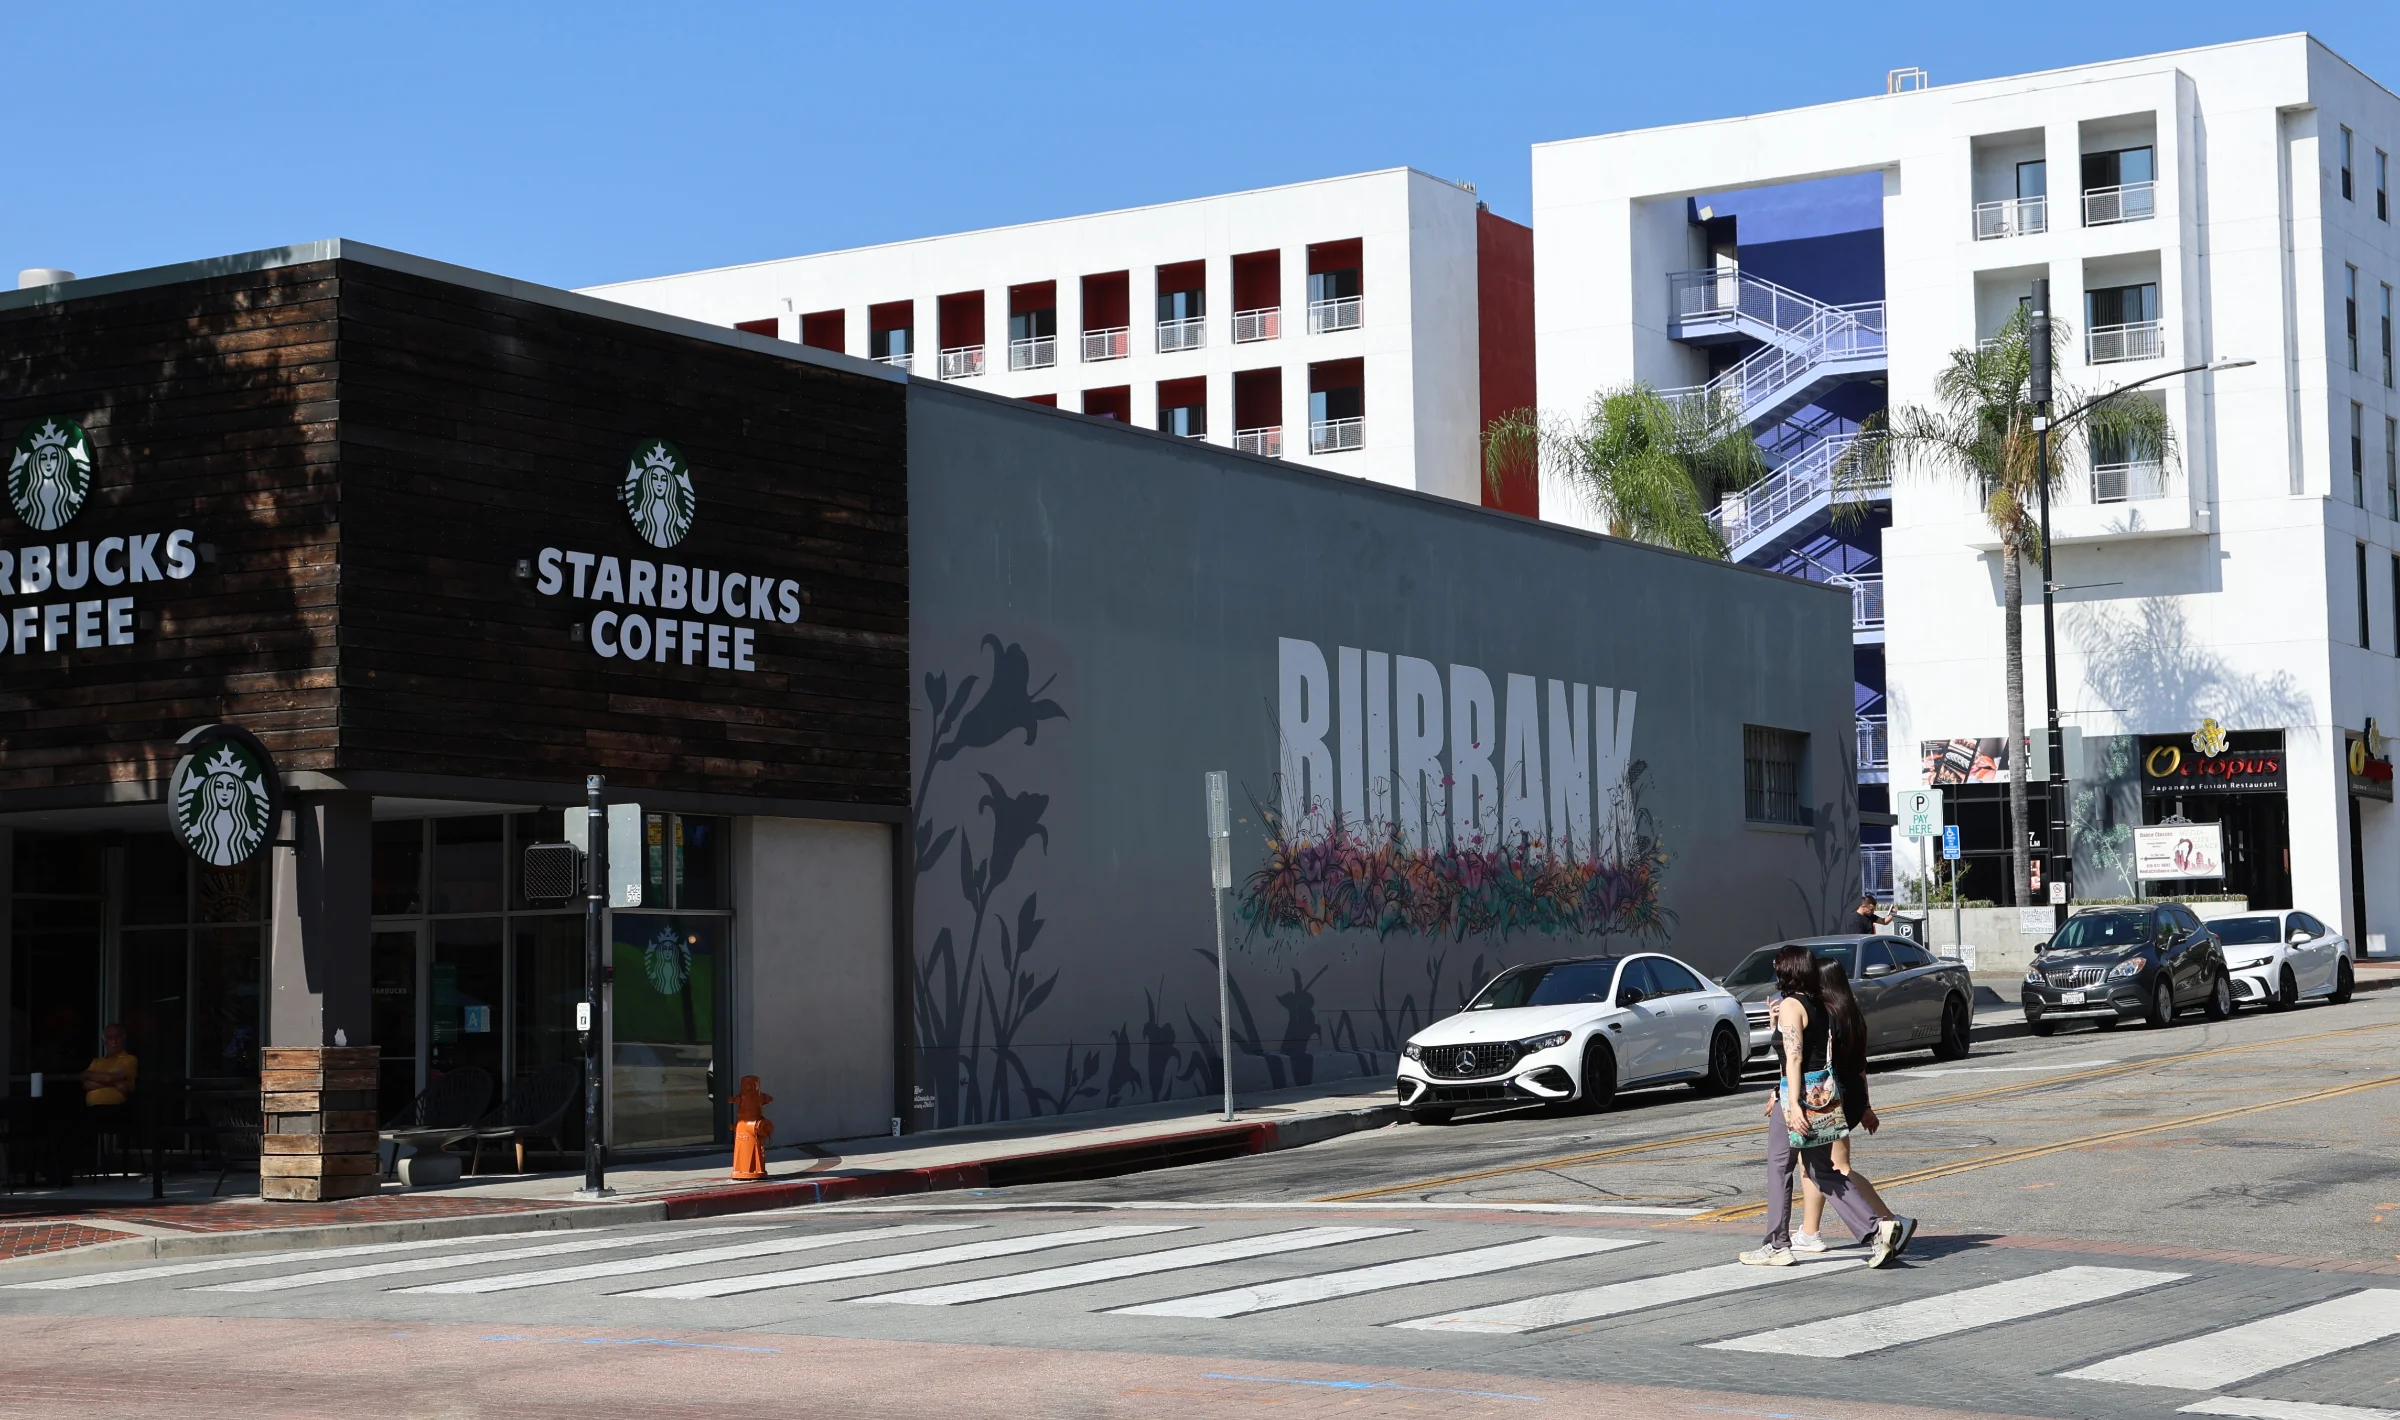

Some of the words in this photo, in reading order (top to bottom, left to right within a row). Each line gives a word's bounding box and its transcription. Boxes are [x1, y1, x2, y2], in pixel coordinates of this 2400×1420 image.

[536, 546, 800, 624] STARBUCKS
[0, 596, 134, 655] FFEE
[590, 610, 755, 672] COFFEE
[1278, 636, 1637, 868] BURBANK
[2146, 746, 2279, 779] Octopus
[1917, 796, 1925, 811] P
[1909, 824, 1932, 834] HERE
[1913, 814, 1928, 824] PAY
[467, 1012, 478, 1027] A
[1817, 1134, 1841, 1144] ITALIA
